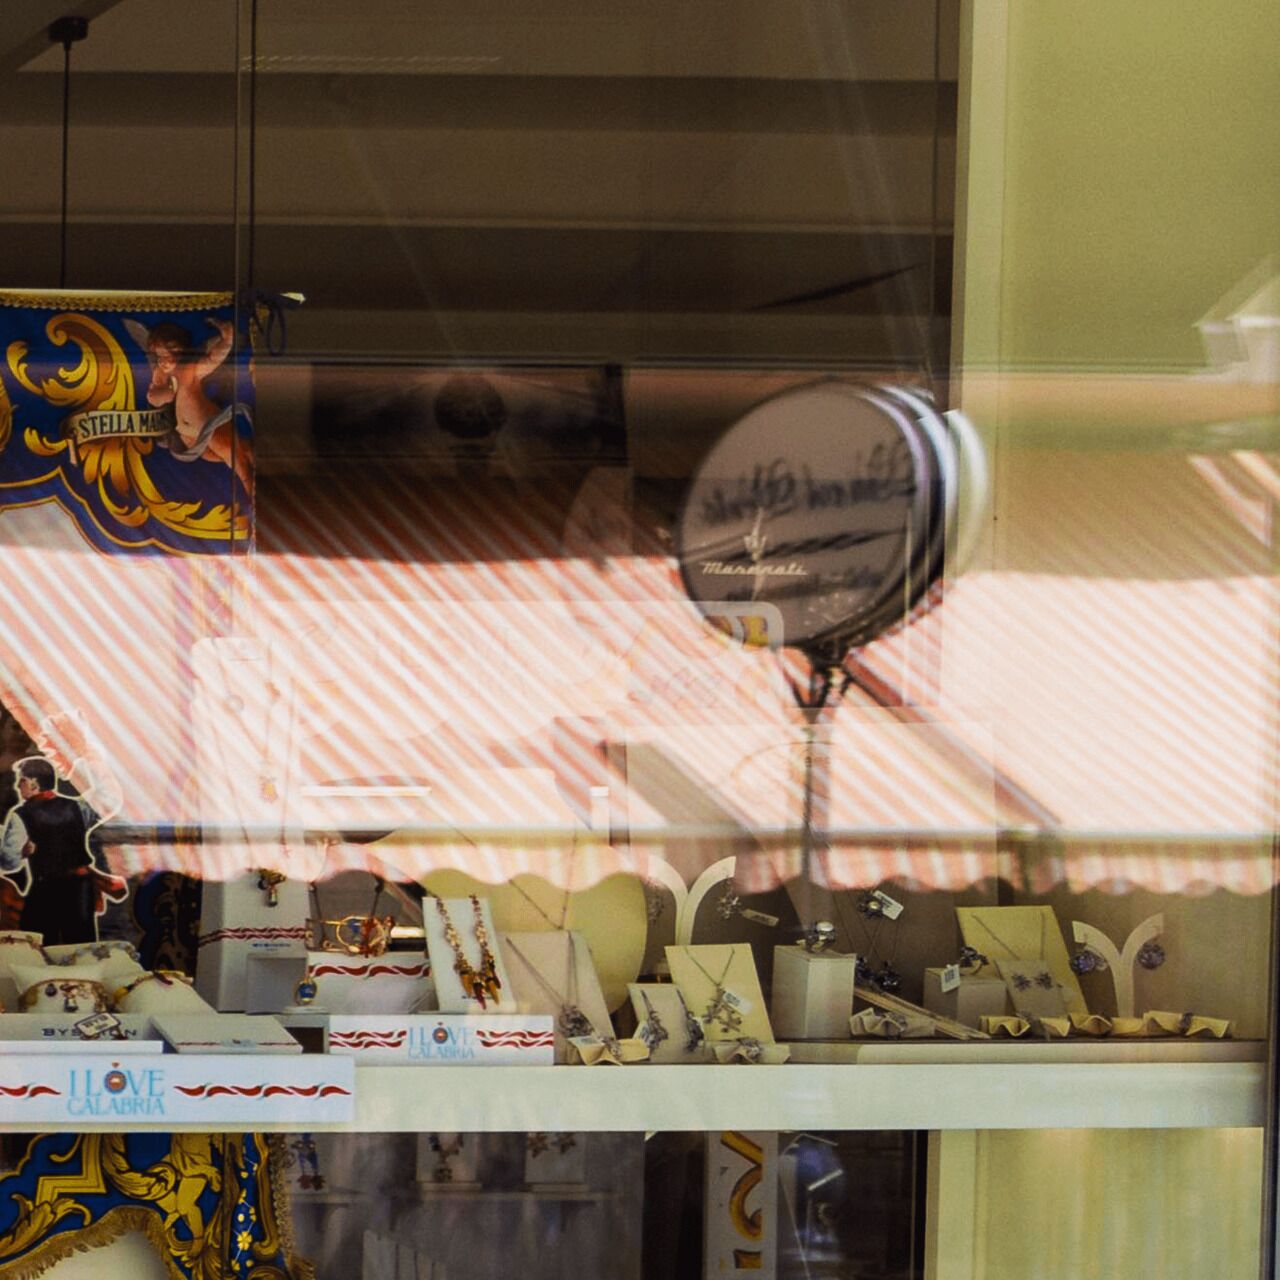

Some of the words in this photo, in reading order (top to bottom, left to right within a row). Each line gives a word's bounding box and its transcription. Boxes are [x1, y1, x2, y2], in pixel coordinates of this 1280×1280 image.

[79, 413, 136, 439] STELLA
[69, 1069, 78, 1097] I
[85, 1068, 166, 1097] LOVE
[66, 1097, 166, 1116] CALABRIA
